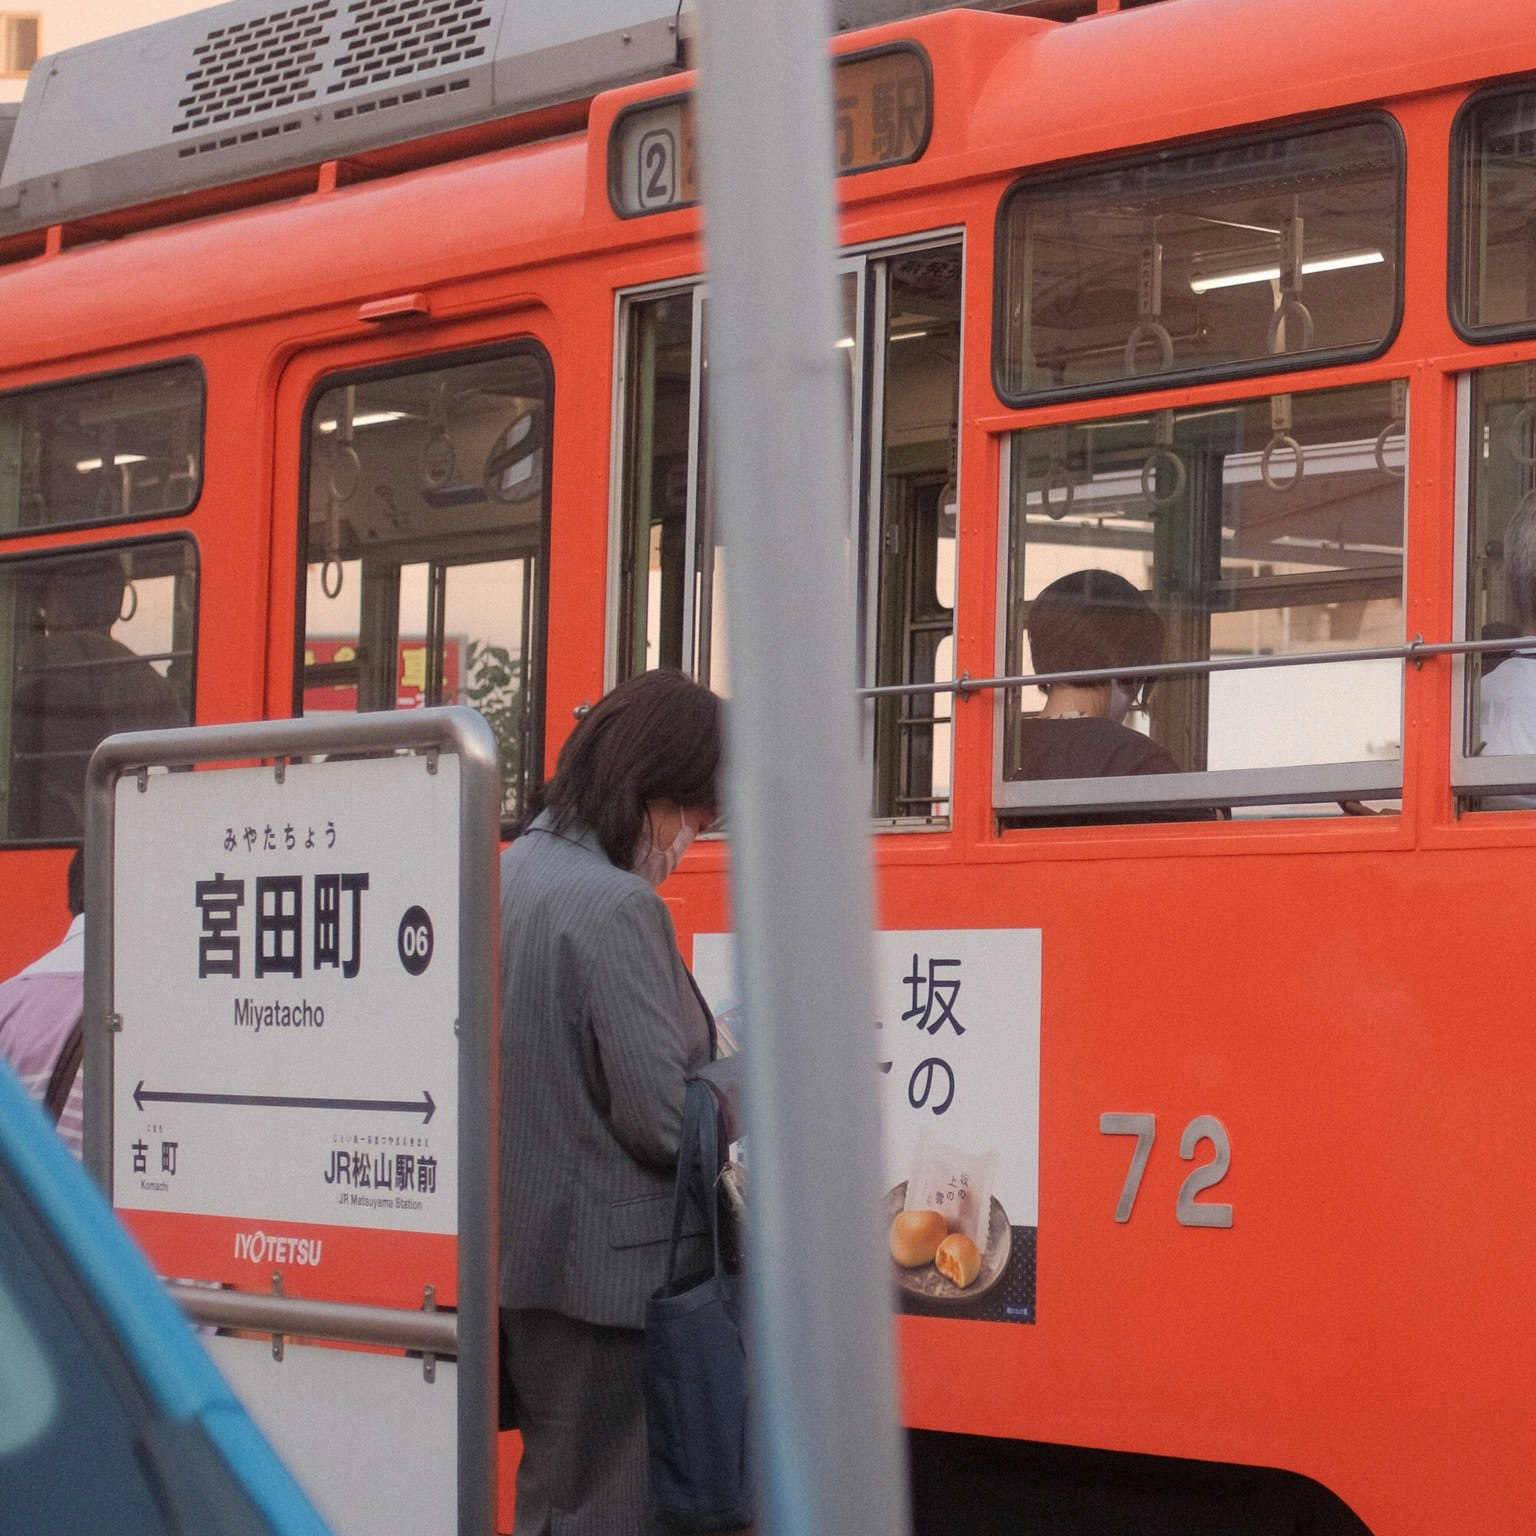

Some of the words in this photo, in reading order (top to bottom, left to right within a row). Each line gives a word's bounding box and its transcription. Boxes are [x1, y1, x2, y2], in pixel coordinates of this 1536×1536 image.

[645, 141, 667, 199] 2
[223, 821, 336, 852] みやたちょう
[195, 872, 370, 979] 宮田町
[402, 925, 429, 957] 06
[233, 998, 325, 1033] Miyatacho
[324, 1150, 438, 1194] JR松山駅前
[1099, 1112, 1234, 1228] 72
[339, 1193, 349, 1205] JR
[350, 1194, 394, 1210] Matsuyama
[395, 1196, 423, 1210] Station
[233, 1229, 322, 1267] IYOTETSU
